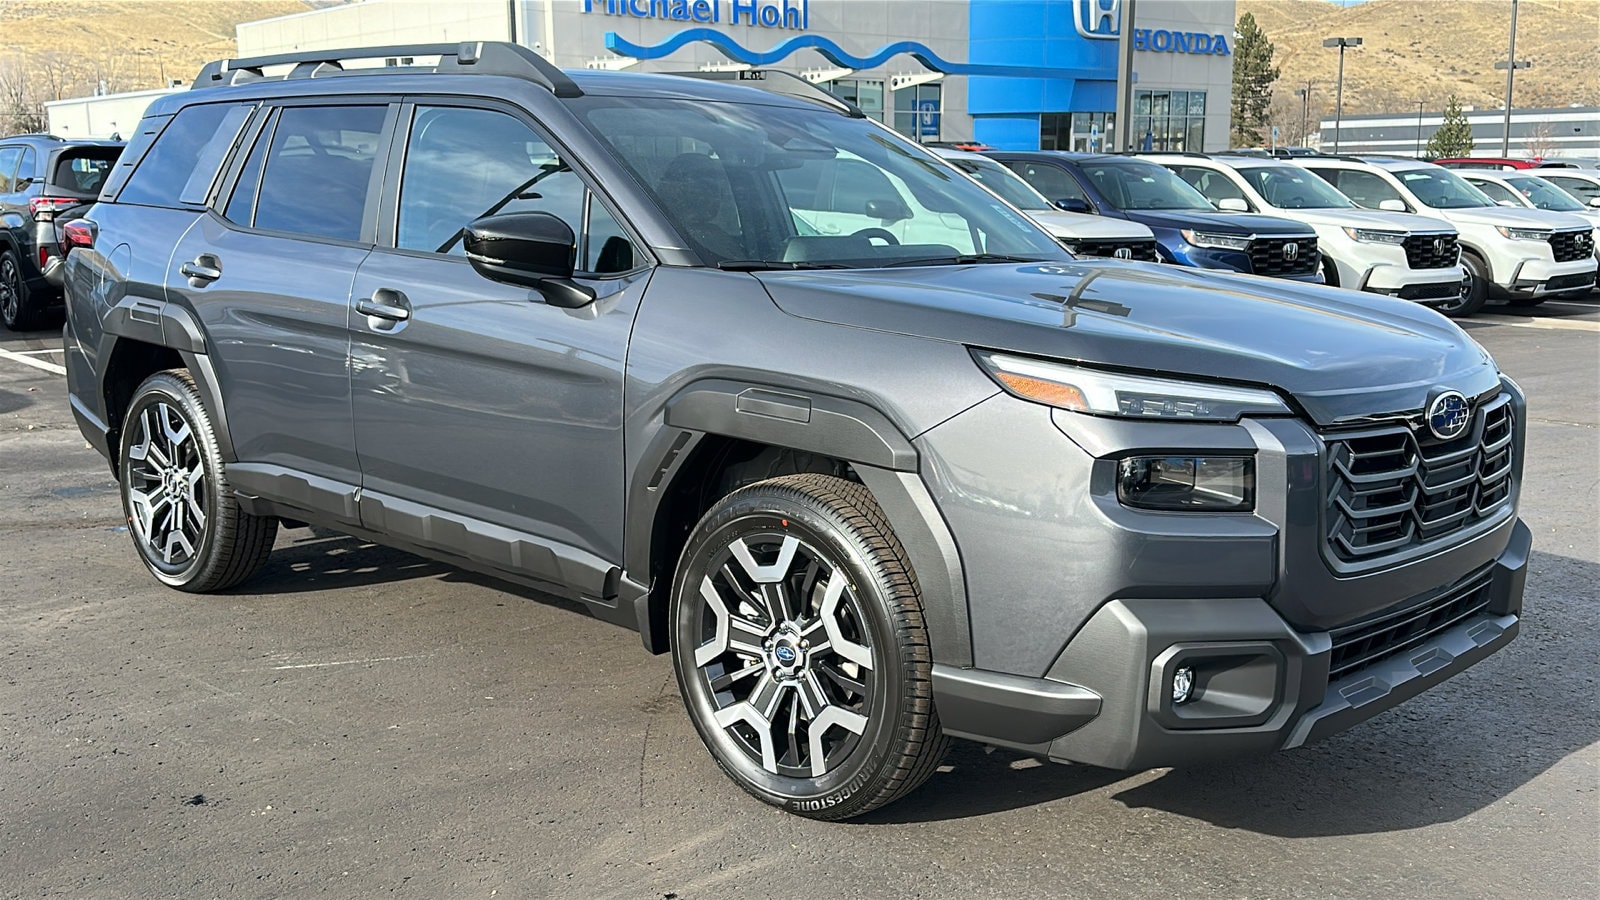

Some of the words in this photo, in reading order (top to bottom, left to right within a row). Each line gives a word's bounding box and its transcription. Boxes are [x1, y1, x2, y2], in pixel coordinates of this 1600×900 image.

[729, 0, 808, 30] Hohl
[1133, 28, 1231, 56] HONDA
[792, 757, 878, 811] BRIDGESTONE
